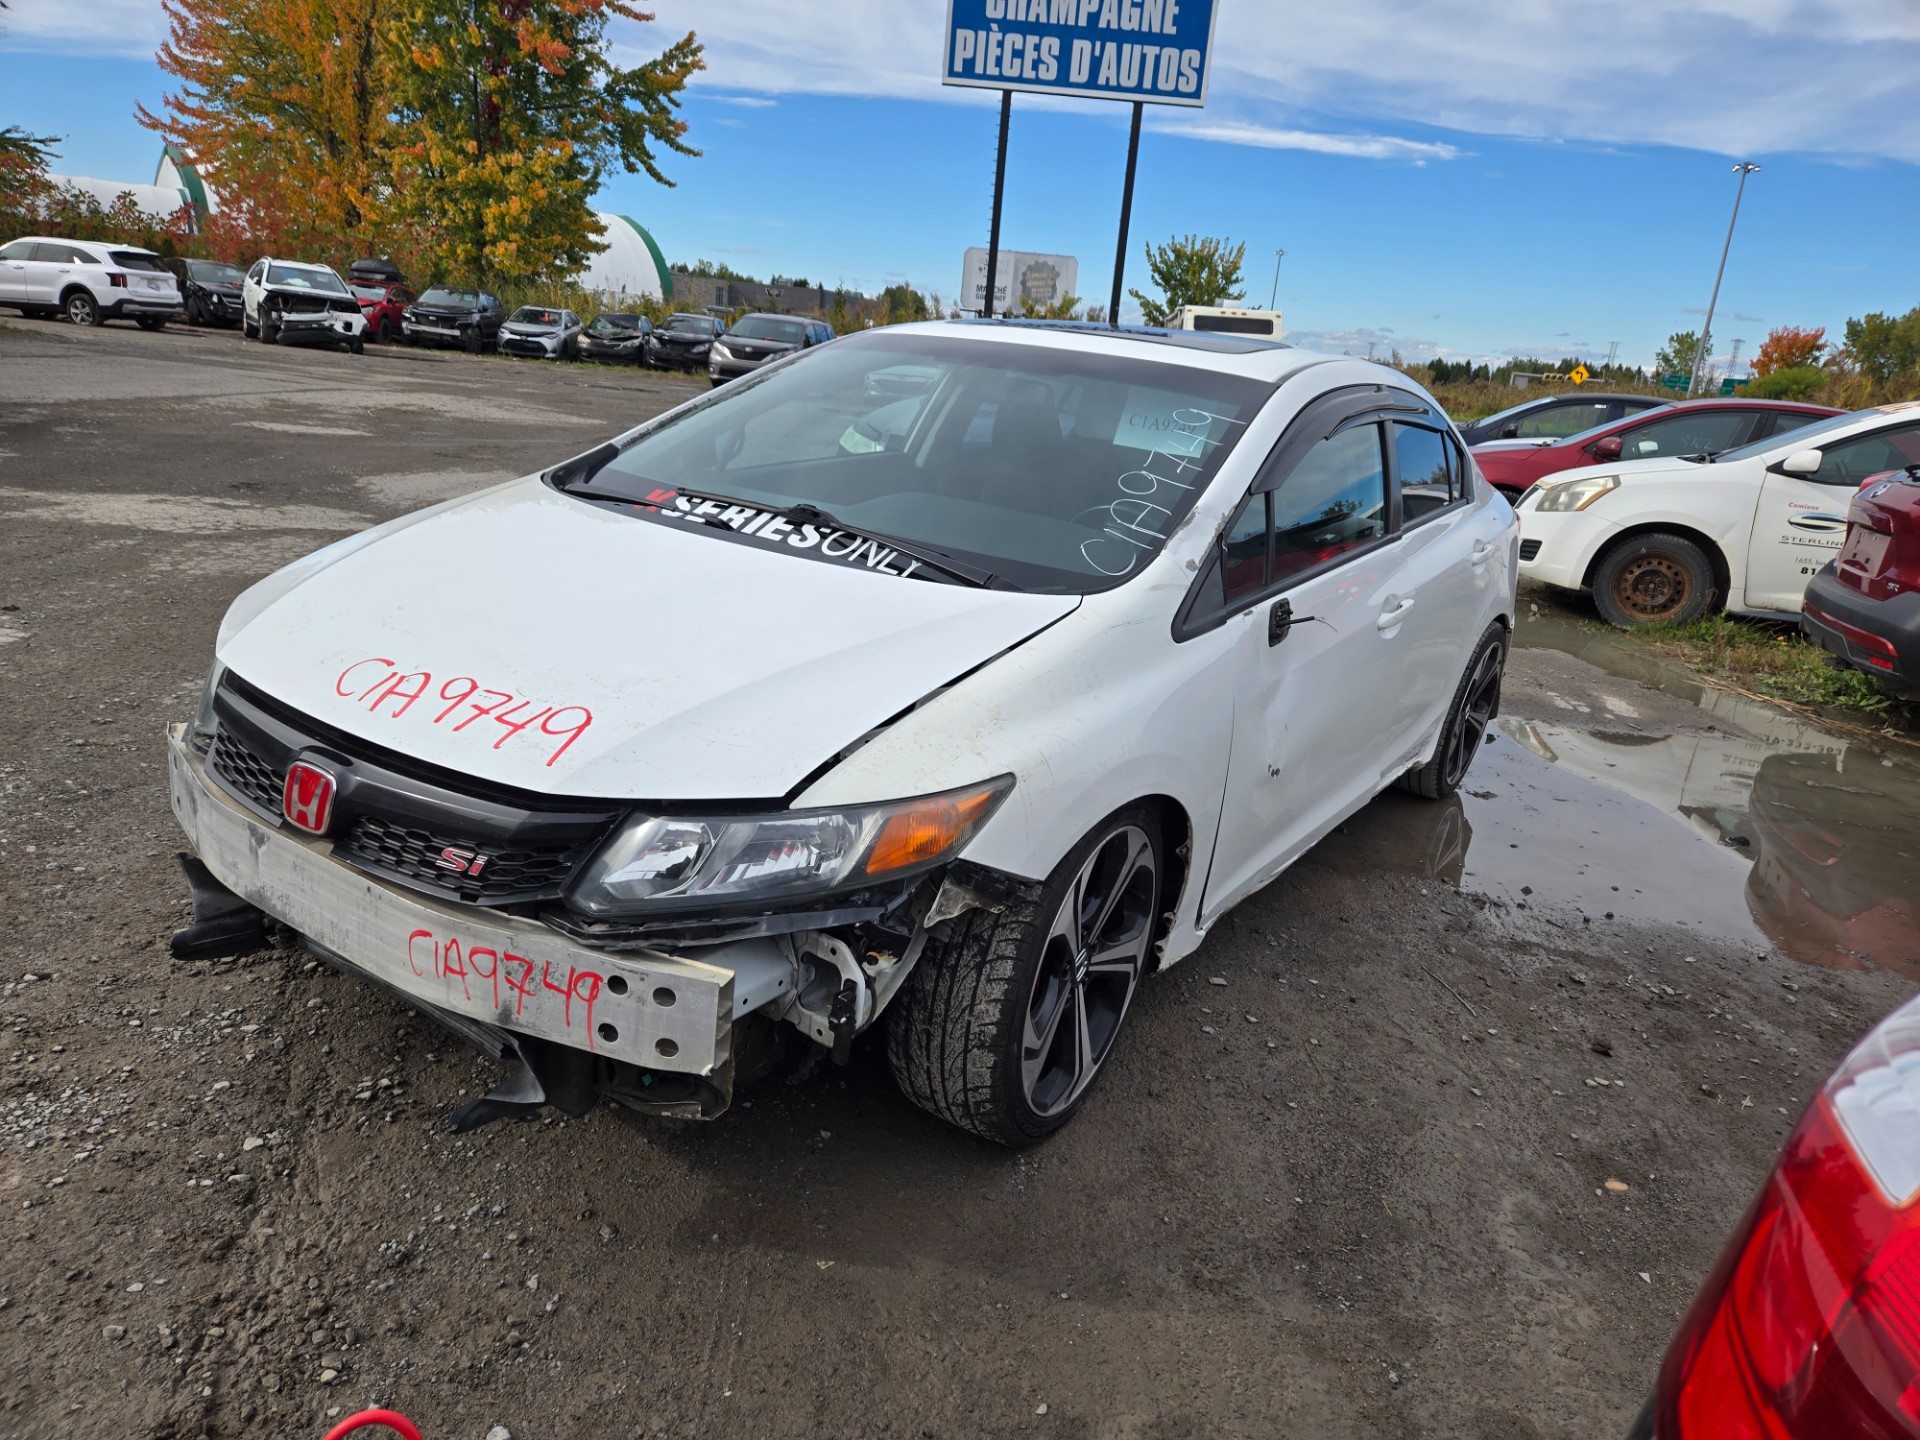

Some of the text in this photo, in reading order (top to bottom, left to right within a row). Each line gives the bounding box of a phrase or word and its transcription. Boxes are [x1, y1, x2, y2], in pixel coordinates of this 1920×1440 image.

[953, 23, 1201, 93] PIÈCES D'AUTOS
[976, 284, 1008, 295] MACHÉ
[1128, 413, 1197, 435] C1A9749
